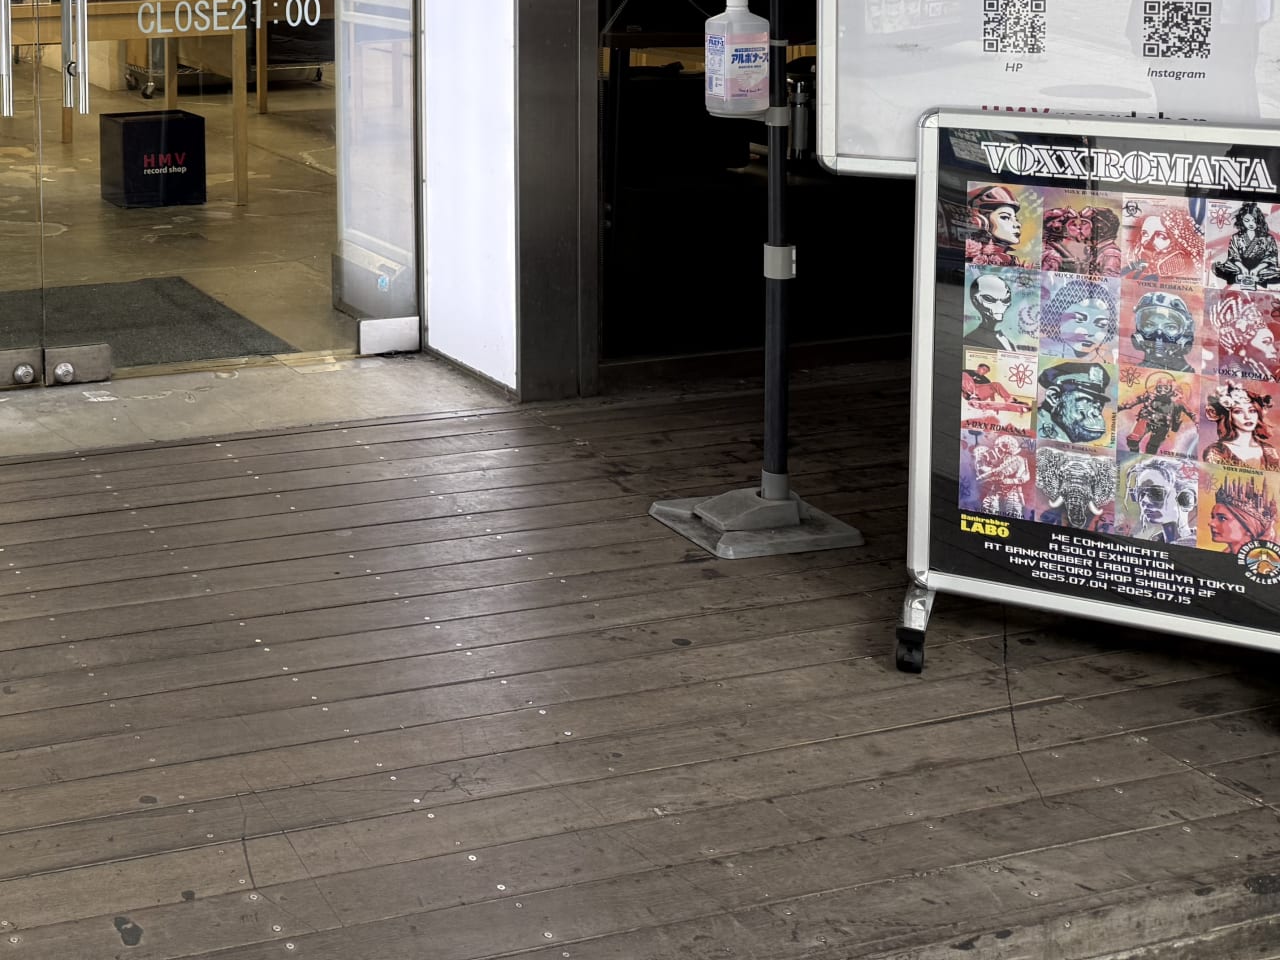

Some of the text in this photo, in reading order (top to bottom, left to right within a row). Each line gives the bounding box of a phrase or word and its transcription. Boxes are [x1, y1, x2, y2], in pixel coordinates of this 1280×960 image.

[1004, 62, 1024, 73] HP
[1146, 67, 1206, 81] Instagram
[143, 152, 186, 168] HMV
[144, 165, 187, 175] record shop
[981, 141, 1277, 193] VOXX ROMANA
[961, 520, 1010, 538] LABO
[1052, 533, 1170, 560] WE COMMUNICATE
[1049, 543, 1175, 571] A SOLO EXHIBITION
[984, 542, 1246, 594] AT BANKROBBER LABO SHIBUYA TOKYO
[1010, 556, 1217, 599] HMV RECORD SHOP SHIBUYA 2F
[1031, 570, 1108, 590] 2025.07.04
